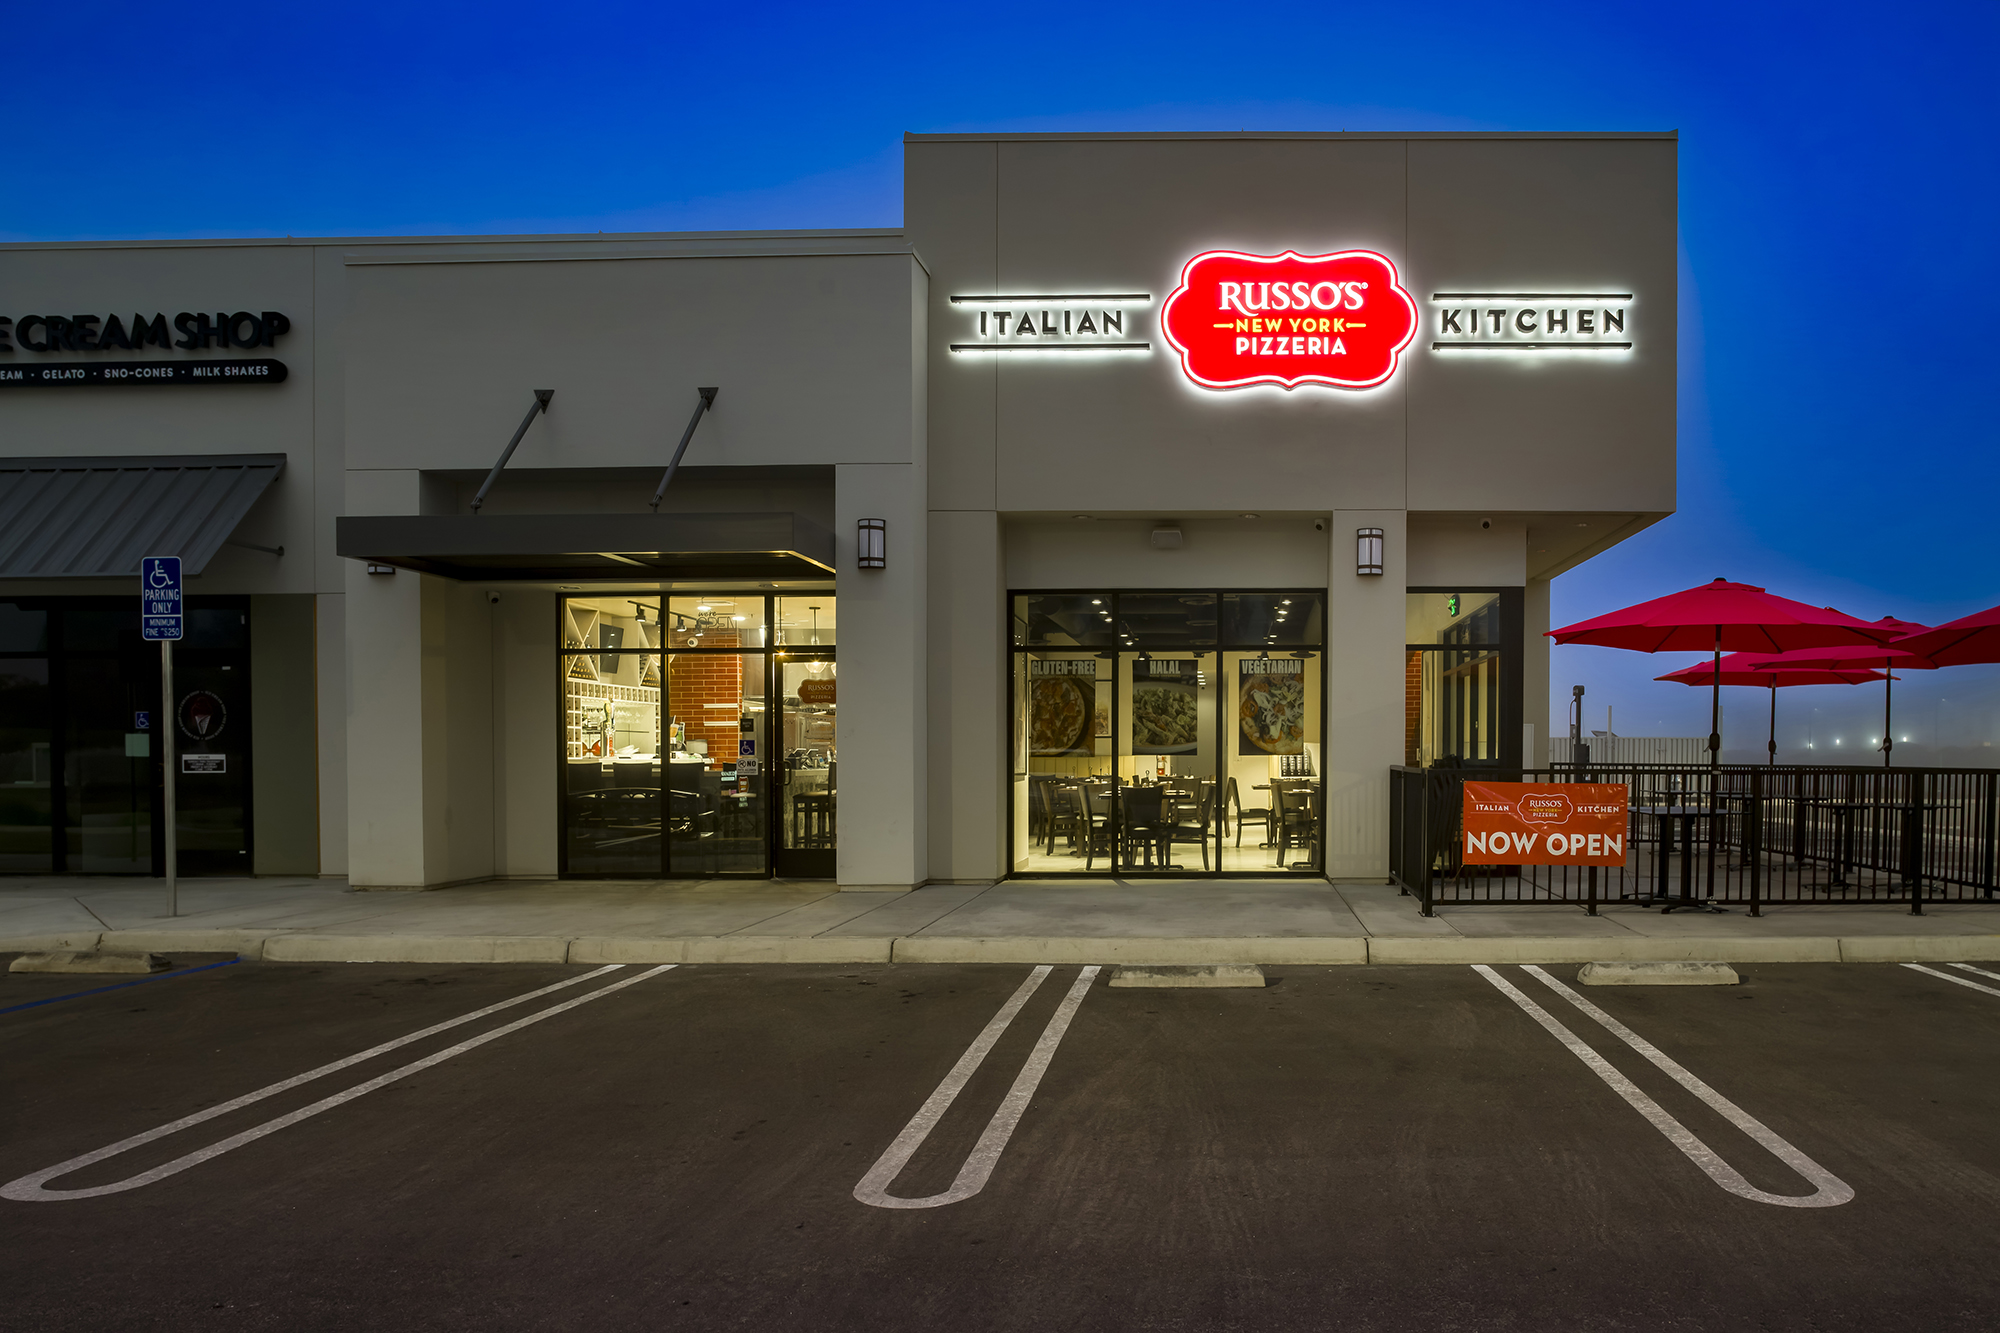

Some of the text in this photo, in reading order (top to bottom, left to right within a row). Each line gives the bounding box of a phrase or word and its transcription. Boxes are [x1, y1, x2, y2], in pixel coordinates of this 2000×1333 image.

[980, 310, 1122, 336] ITALIAN
[1236, 318, 1345, 332] NEW YORK
[1441, 309, 1624, 334] KITCHEN
[16, 312, 172, 352] CREAM
[174, 311, 290, 350] SHOP
[1236, 337, 1347, 355] PIZZERIA
[42, 369, 86, 380] GELATO
[104, 367, 173, 379] SNO-CONES
[193, 366, 220, 377] MILK
[224, 365, 269, 376] SHAKES
[145, 589, 179, 600] PARKING
[152, 602, 172, 613] ONLY
[146, 628, 159, 636] FINE
[1031, 661, 1095, 675] GLUTEN-FREE
[1149, 661, 1181, 674] HALAL
[1242, 660, 1301, 674] VEGETARIAN
[1475, 804, 1510, 812] ITALIAN
[1529, 799, 1562, 808] RUSSO'S
[1577, 805, 1620, 813] KITCHEN
[1467, 831, 1622, 857] NOW OPEN
